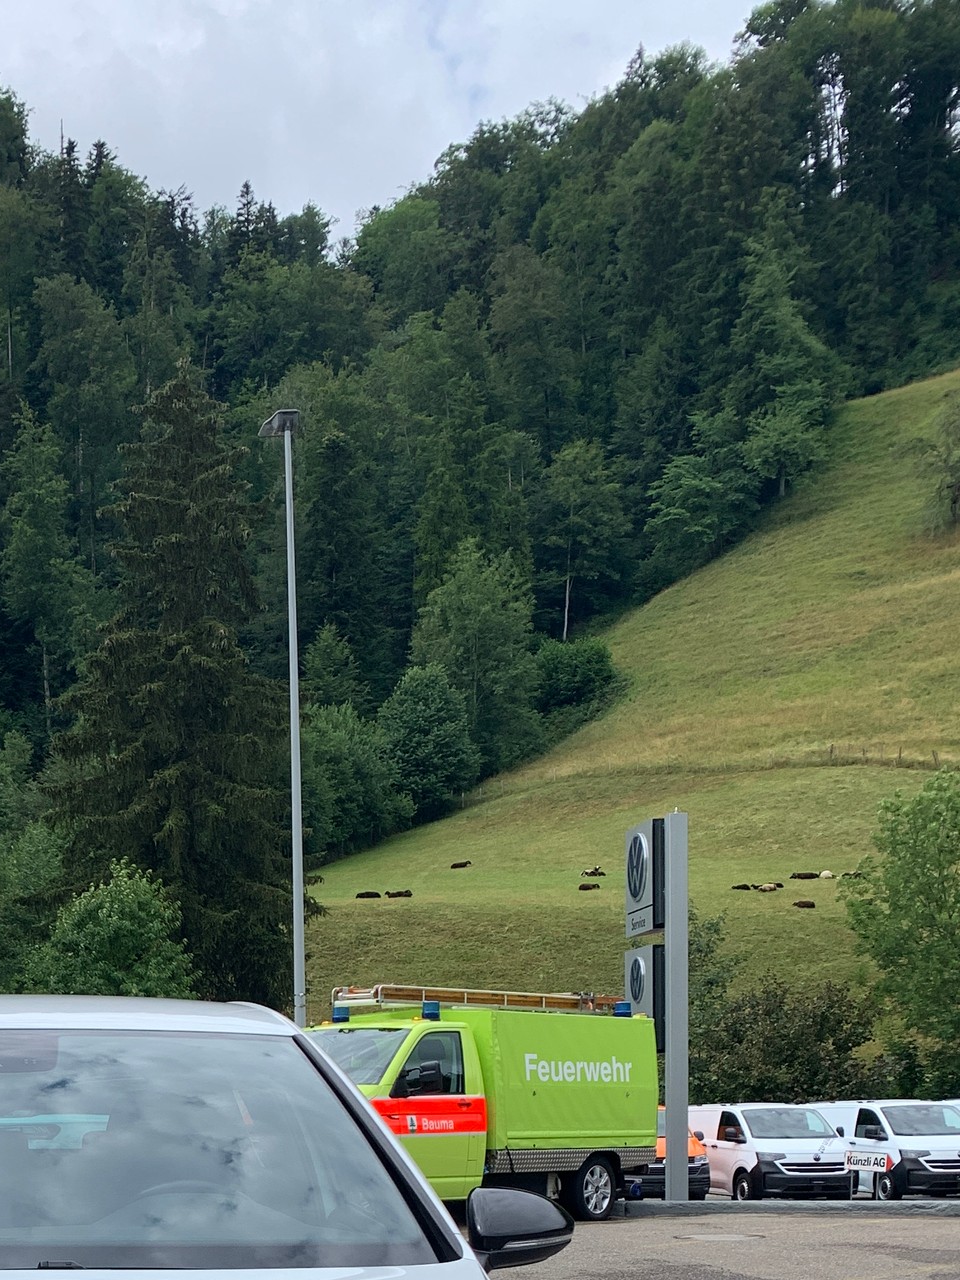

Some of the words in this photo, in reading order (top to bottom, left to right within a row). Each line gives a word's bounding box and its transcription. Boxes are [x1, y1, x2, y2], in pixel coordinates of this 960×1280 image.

[524, 1053, 632, 1083] Feuerwehr
[422, 1117, 454, 1131] Bauma
[846, 1155, 872, 1167] Künzli
[872, 1157, 886, 1168] AG
